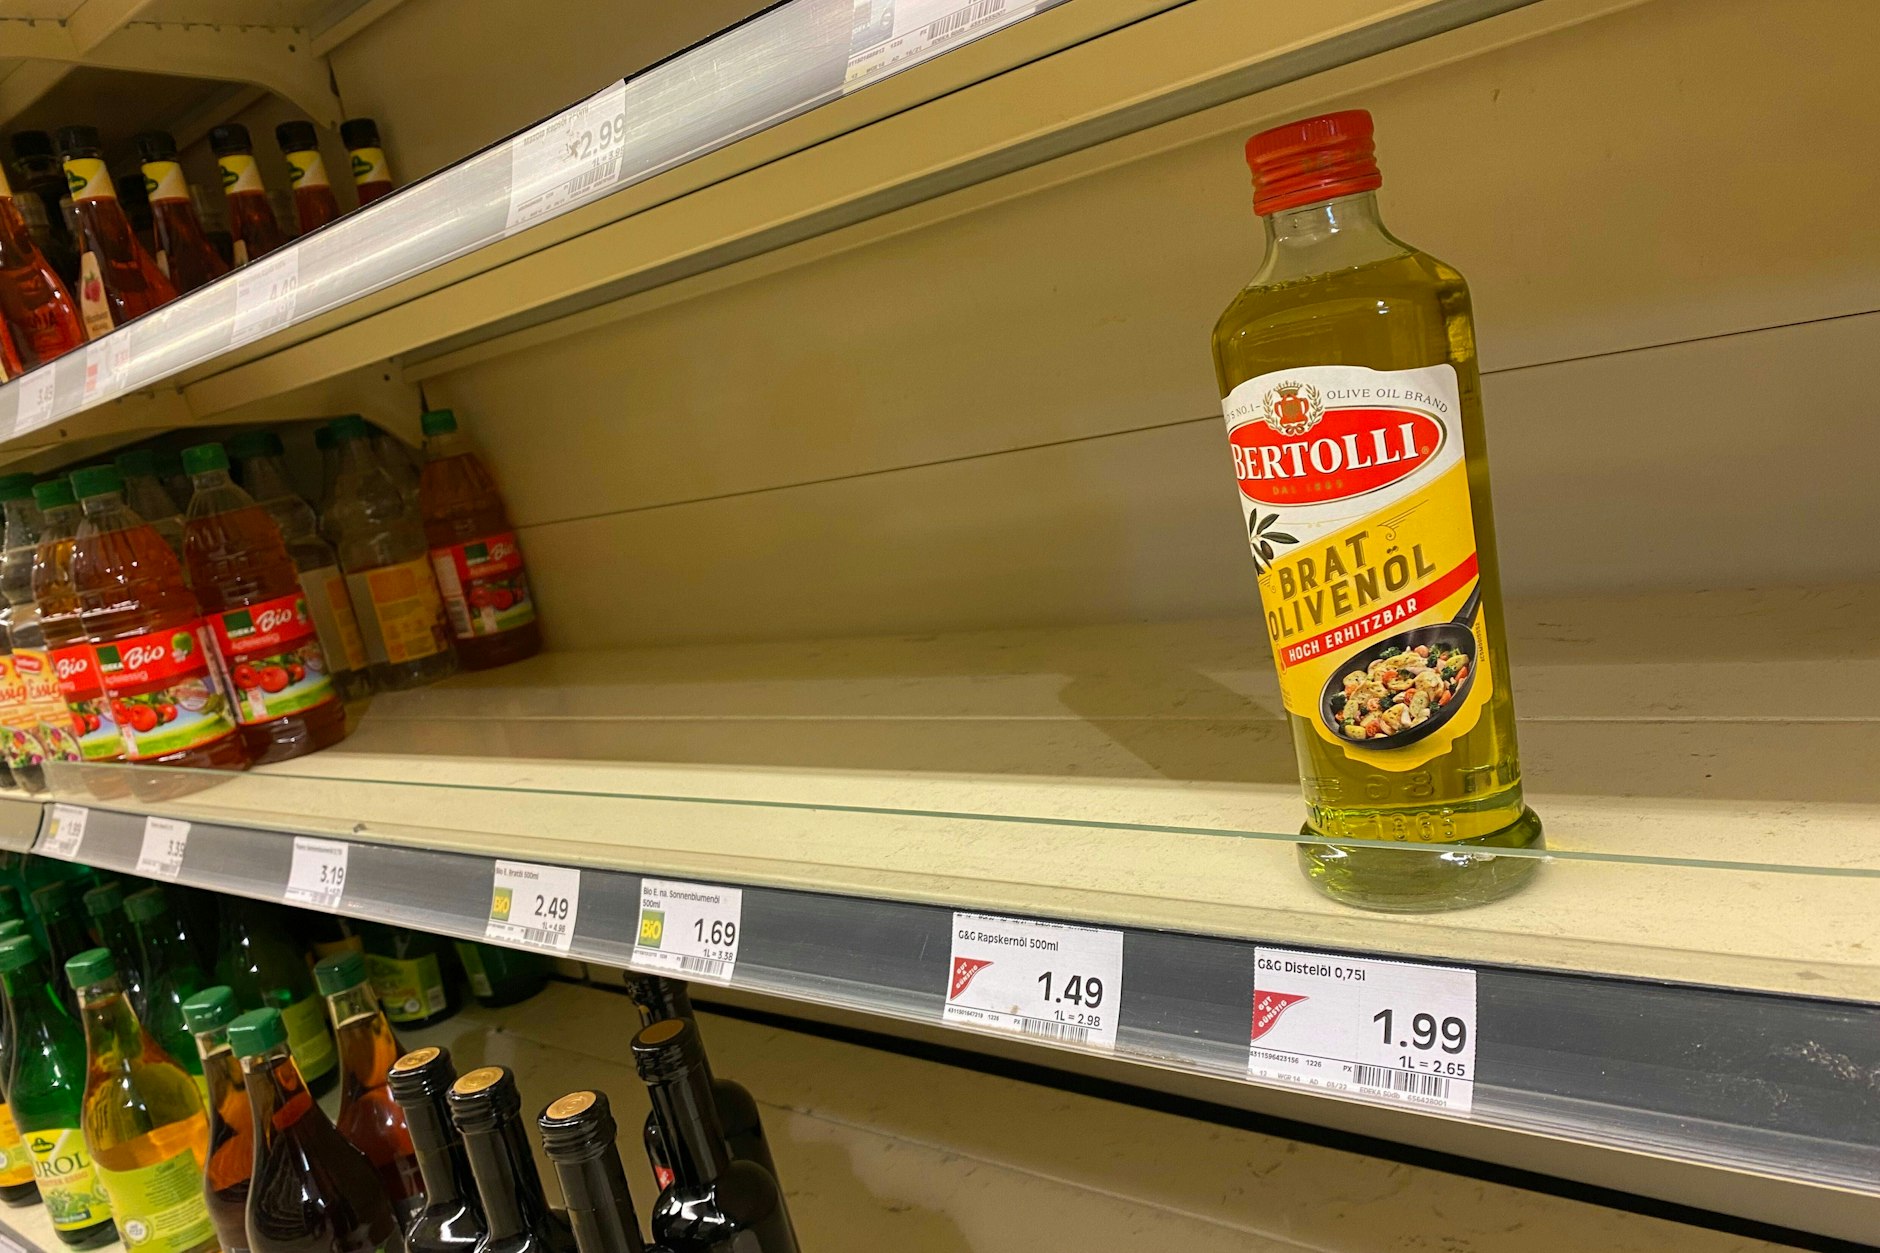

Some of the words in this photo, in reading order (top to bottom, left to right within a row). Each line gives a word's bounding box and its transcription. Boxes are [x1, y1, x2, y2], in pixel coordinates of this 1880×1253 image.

[580, 113, 625, 160] 2.99
[1326, 388, 1371, 400] OLIVE
[1376, 388, 1400, 399] OIL
[1404, 390, 1448, 413] BRAND
[1230, 422, 1418, 481] BERTOLLI
[1278, 530, 1369, 601] BRAT
[1268, 543, 1437, 641] OLIVENÖL
[256, 608, 292, 633] Bio
[1288, 640, 1320, 663] HOCH
[1325, 598, 1418, 649] ERHITZBAR
[56, 657, 88, 679] Bio
[123, 645, 165, 670] Bio
[320, 865, 344, 885] 3.19
[534, 894, 569, 920] 2.49
[642, 899, 661, 909] 500ml
[643, 887, 652, 895] Bio
[653, 888, 659, 896] E.
[669, 890, 721, 904] Sonnenblumenöl
[694, 918, 736, 947] 1.69
[958, 930, 976, 941] G&G
[977, 932, 1027, 948] Rapskernöl
[1029, 939, 1059, 951] 500ml
[703, 949, 710, 958] 1L
[717, 951, 733, 961] 3.38
[1258, 958, 1282, 973] G&G
[1285, 961, 1331, 978] Distelöl
[1334, 967, 1366, 981] 0,75l
[1038, 971, 1104, 1009] 1.49
[1258, 995, 1272, 1011] GUT
[1054, 1010, 1065, 1022] 1L
[1077, 1013, 1101, 1027] 2.98
[1373, 1008, 1467, 1055] 1.99
[1306, 1060, 1322, 1068] 1226
[1343, 1065, 1352, 1073] PX
[1399, 1056, 1415, 1069] 1L
[1433, 1060, 1466, 1077] 2.65
[1360, 1087, 1381, 1097] EDEKA
[35, 1151, 90, 1177] UROL
